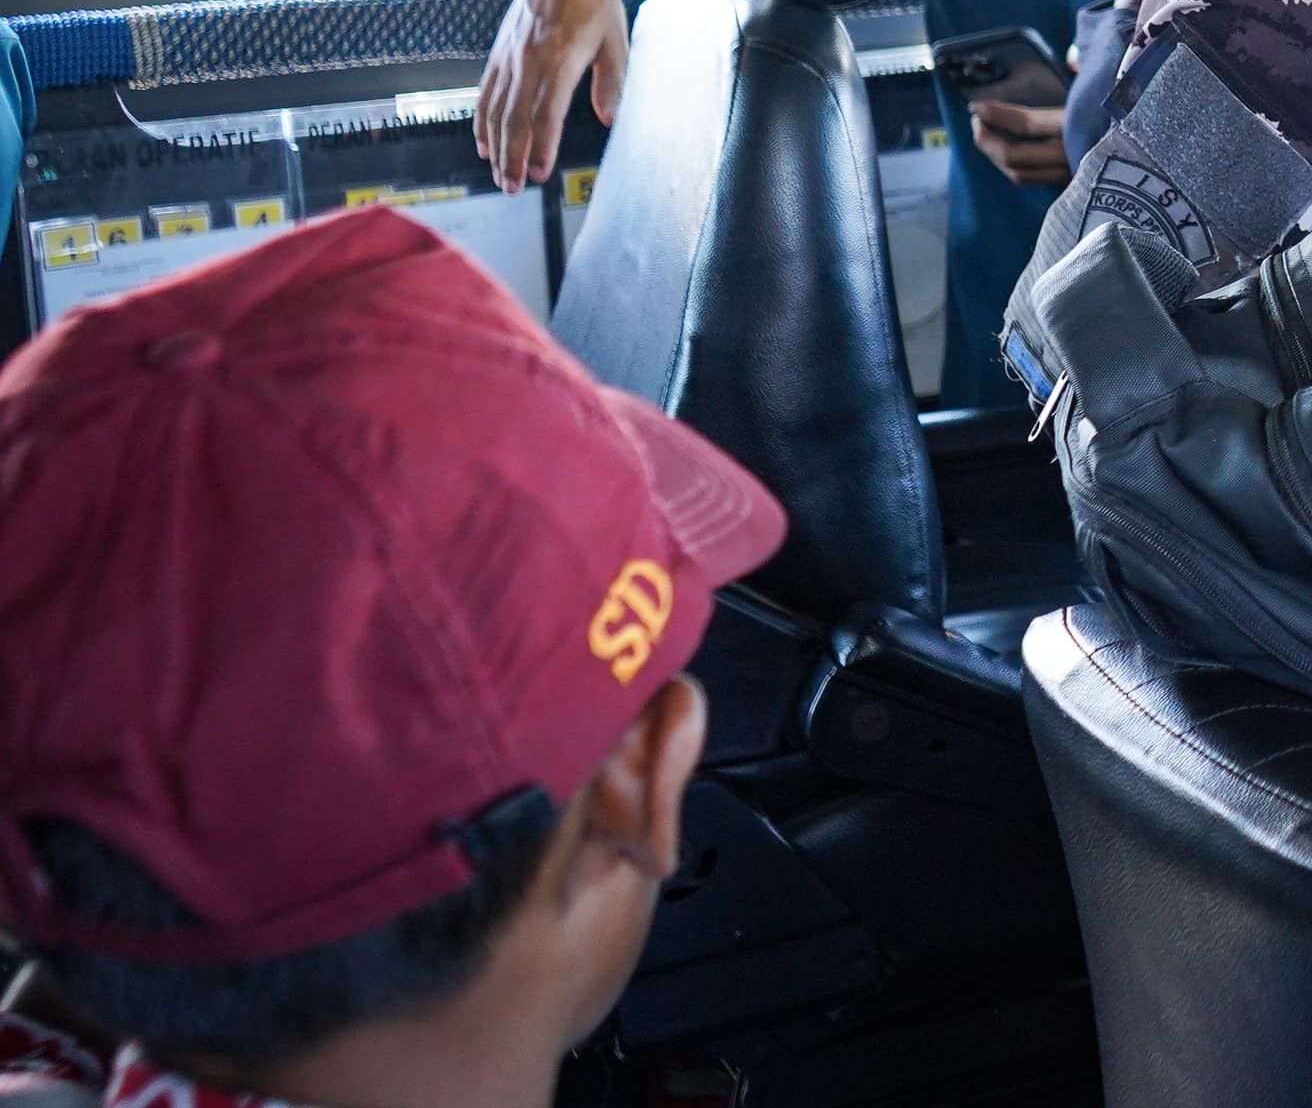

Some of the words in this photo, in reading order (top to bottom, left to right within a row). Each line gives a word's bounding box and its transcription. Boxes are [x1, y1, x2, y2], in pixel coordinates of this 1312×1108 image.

[308, 118, 374, 149] PERAN
[1094, 192, 1143, 220] KORPS
[589, 559, 674, 686] SD
